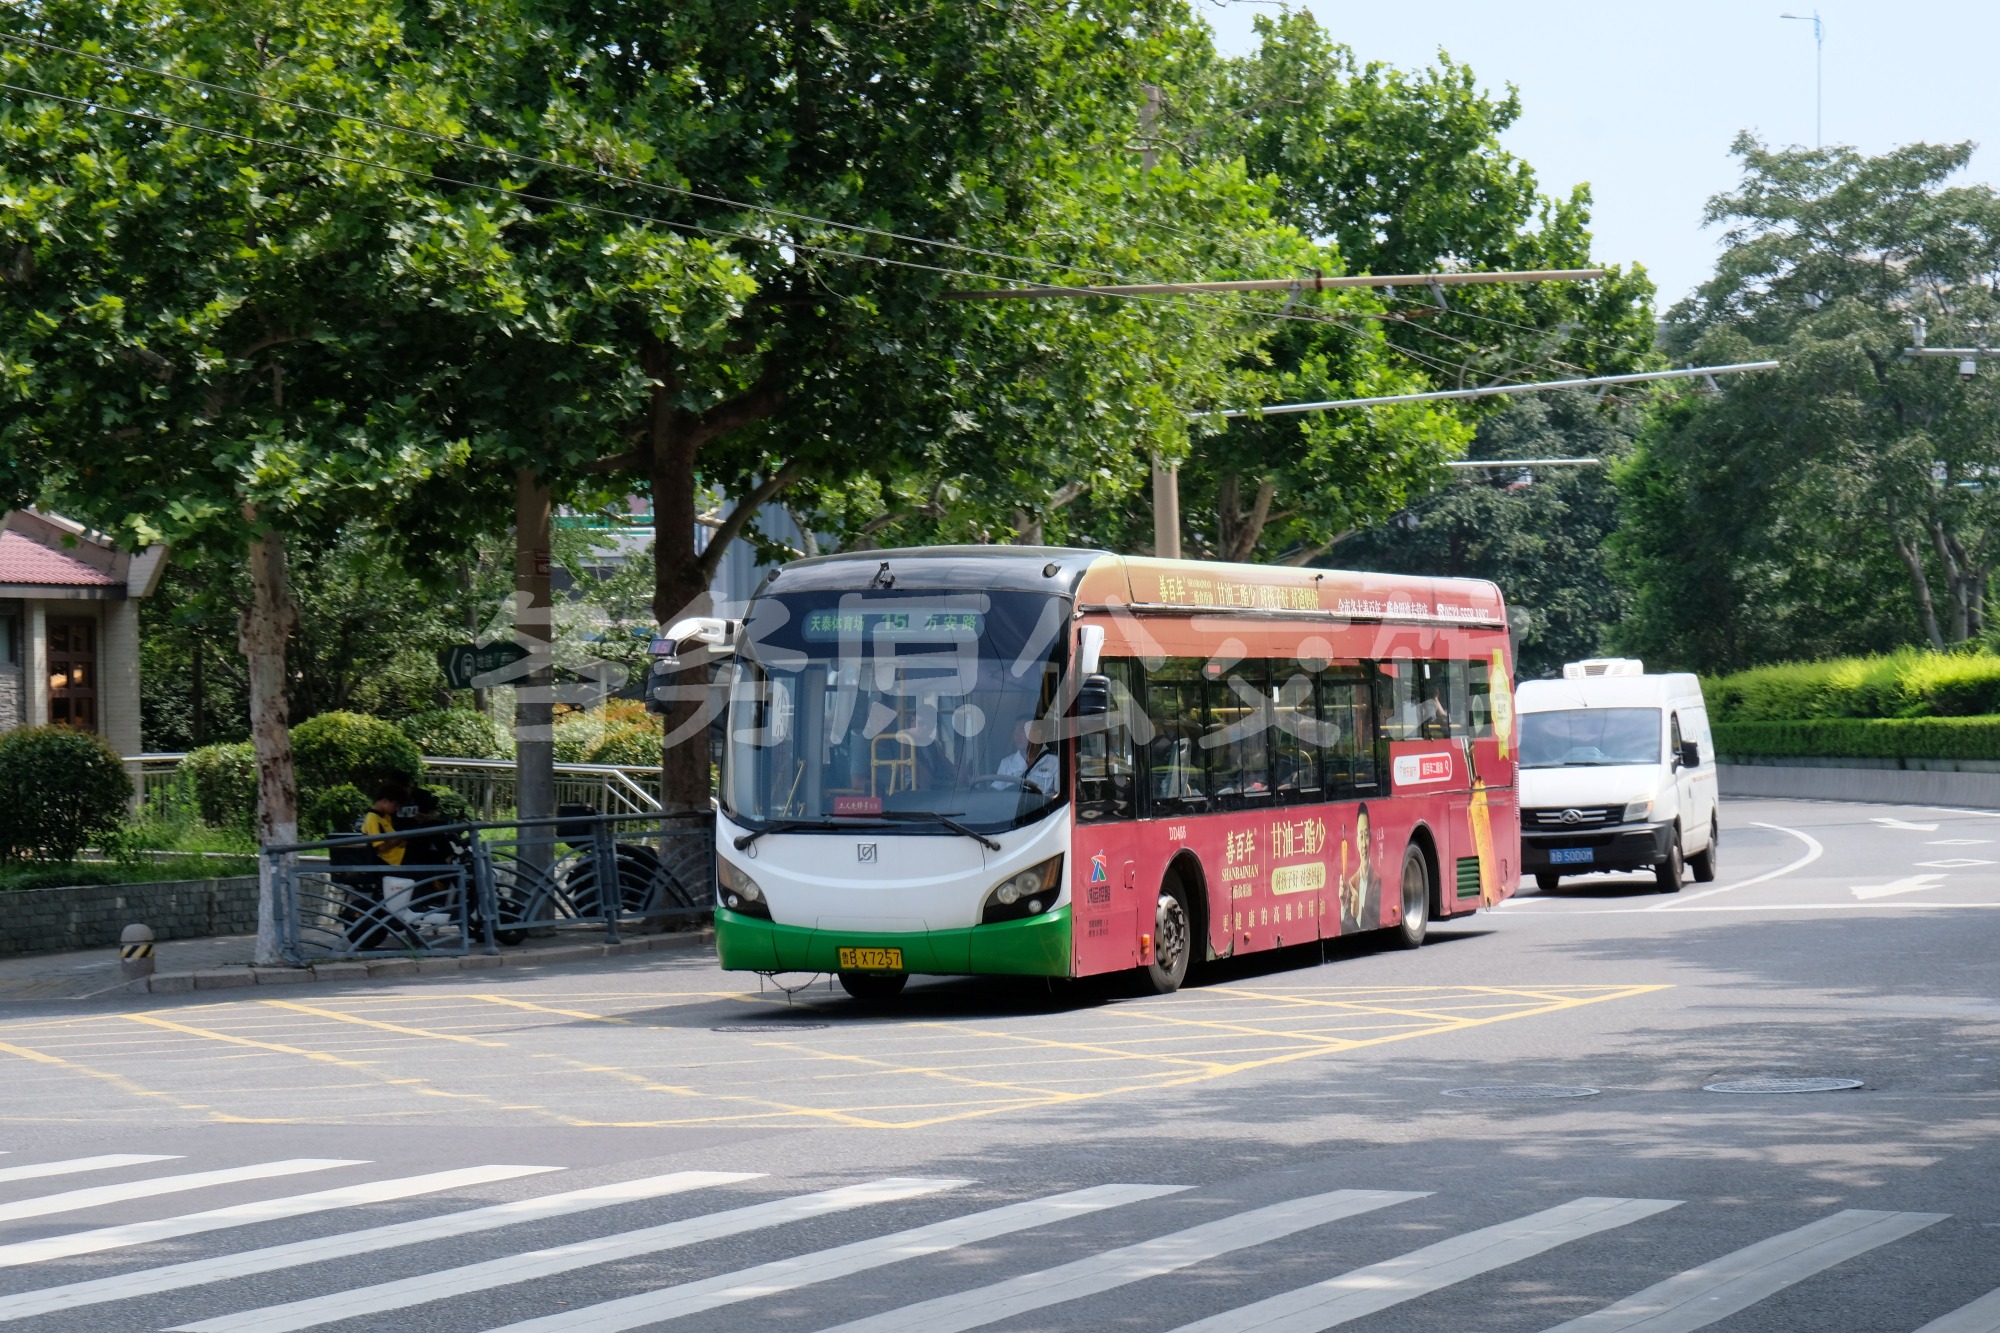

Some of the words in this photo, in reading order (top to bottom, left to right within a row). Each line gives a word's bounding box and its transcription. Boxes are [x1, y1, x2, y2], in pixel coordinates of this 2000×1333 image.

[811, 615, 864, 632] 天泰体育场
[881, 614, 908, 631] 15
[924, 615, 977, 631] 万安路
[654, 641, 669, 654] 15
[1226, 828, 1256, 865] 善百年
[1271, 817, 1326, 860] 甘油三酯少
[1275, 869, 1298, 892] 对孩子好
[1222, 898, 1326, 934] 更健康的高端食用油
